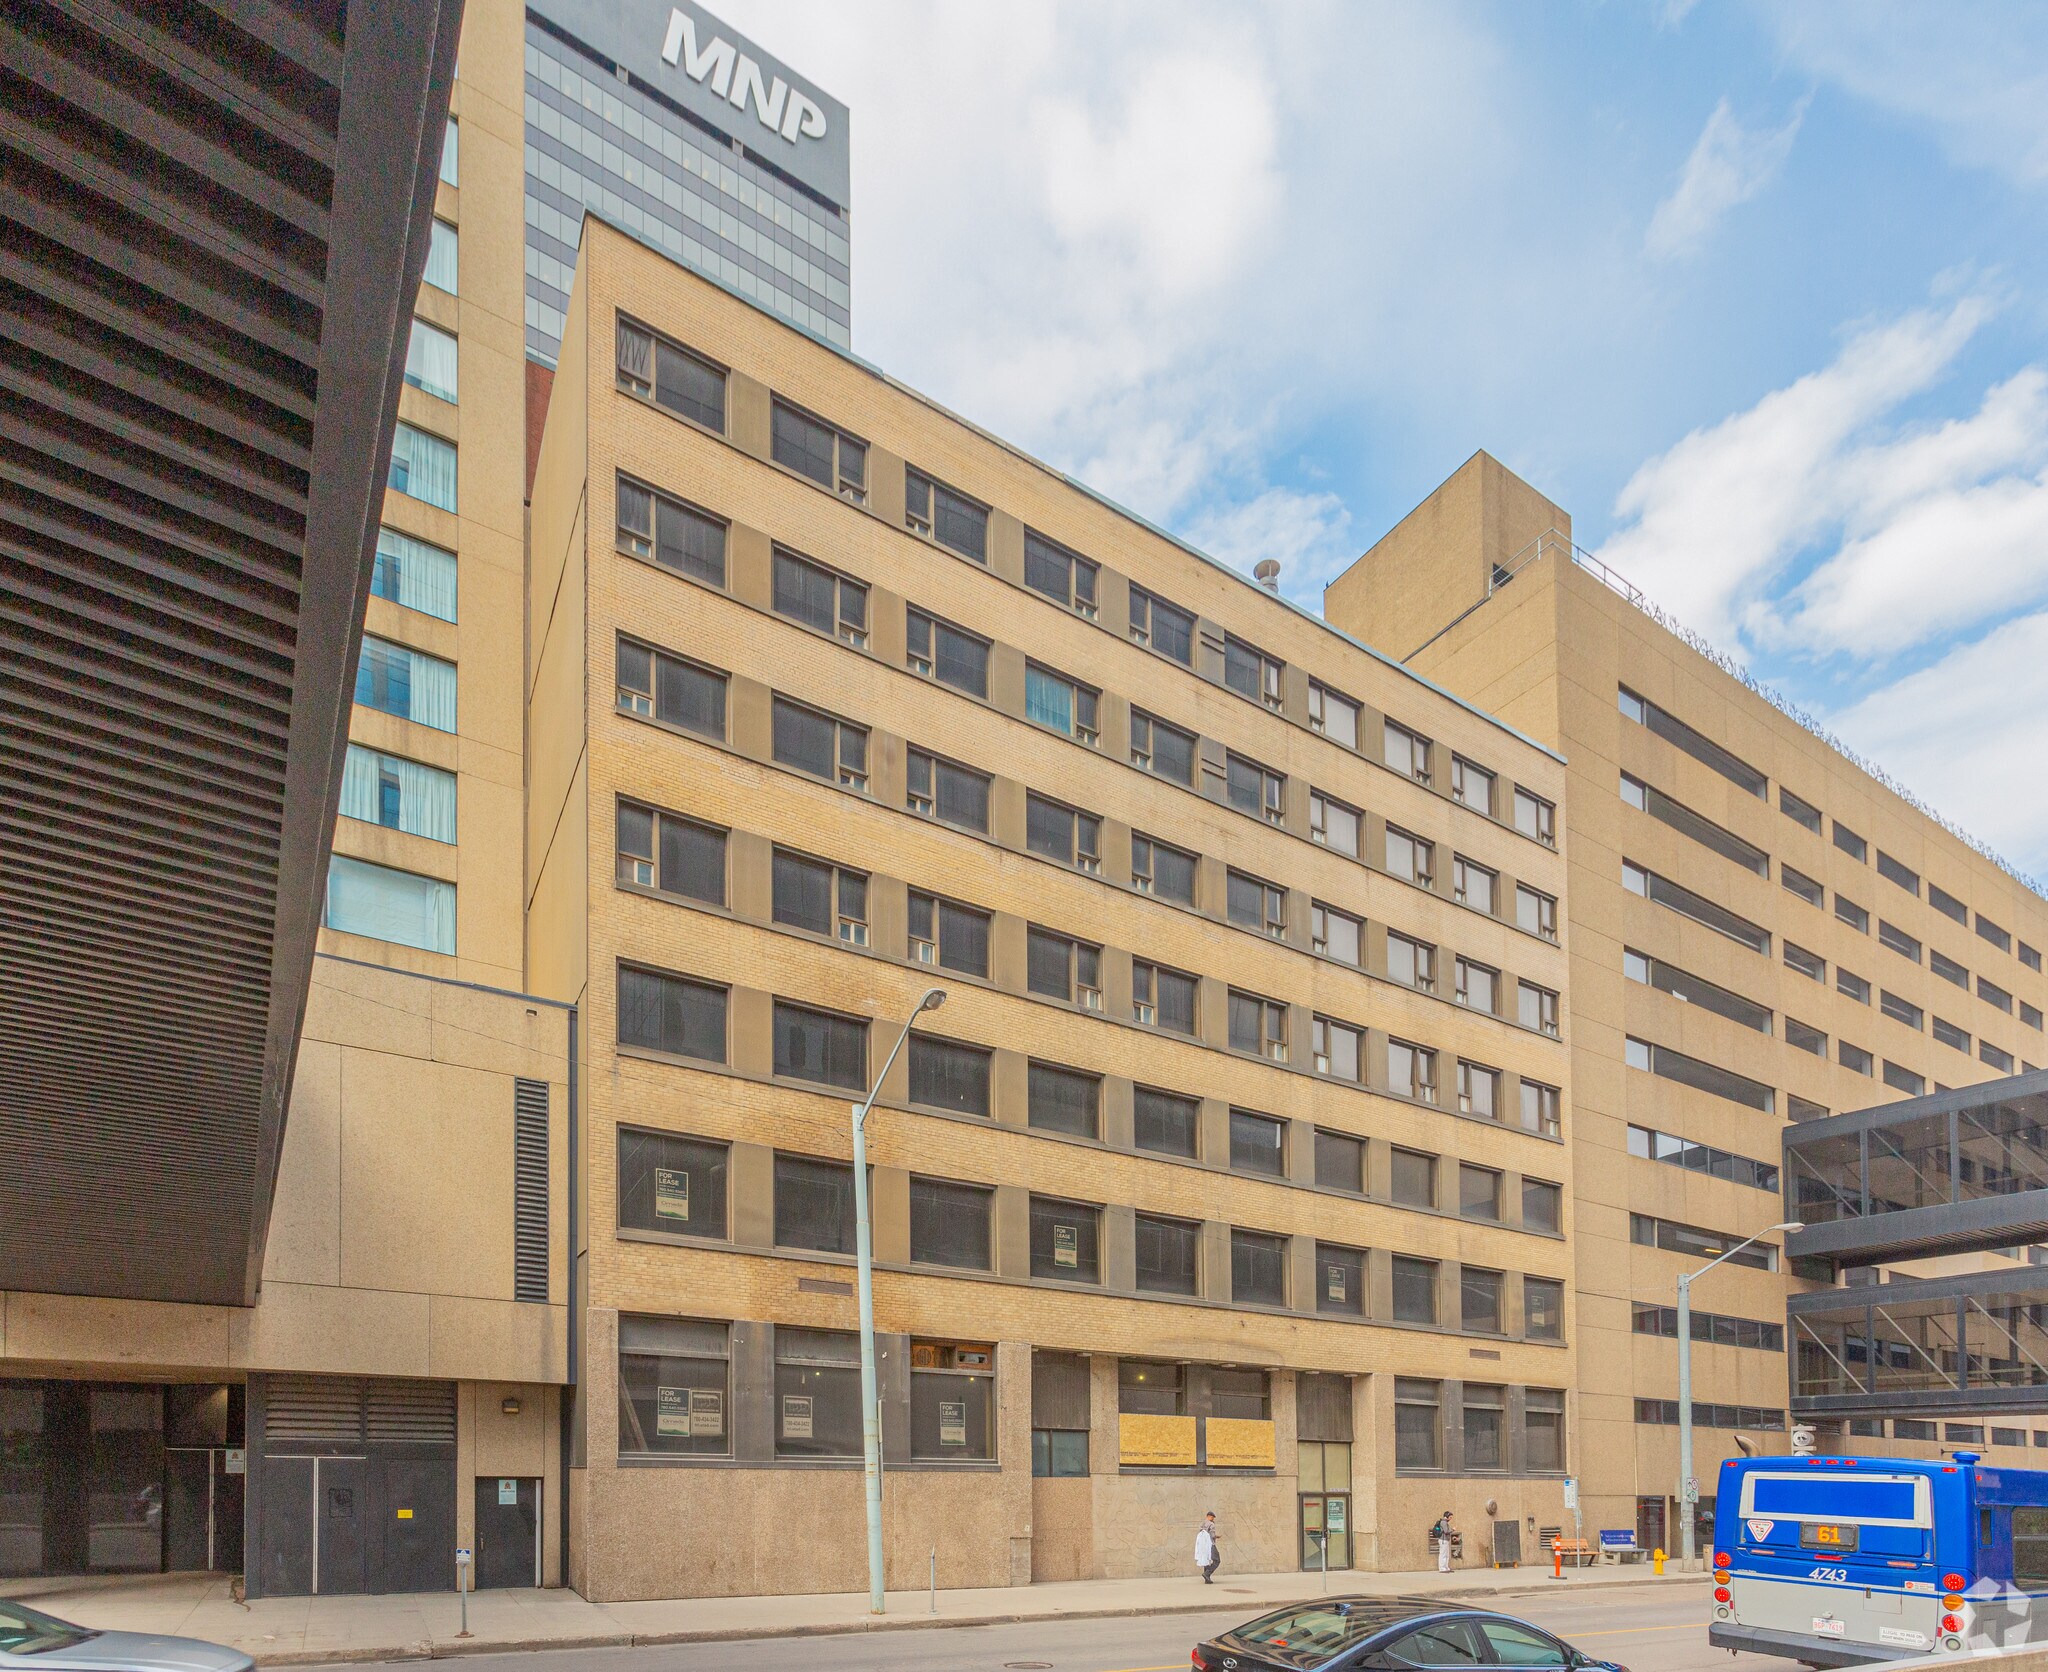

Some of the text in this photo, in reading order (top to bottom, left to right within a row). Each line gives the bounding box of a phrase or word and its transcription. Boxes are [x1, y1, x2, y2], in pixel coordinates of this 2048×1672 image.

[661, 7, 827, 145] MNP
[659, 1178, 680, 1187] LEASE
[1817, 1525, 1841, 1543] 61
[1809, 1567, 1847, 1582] 4743
